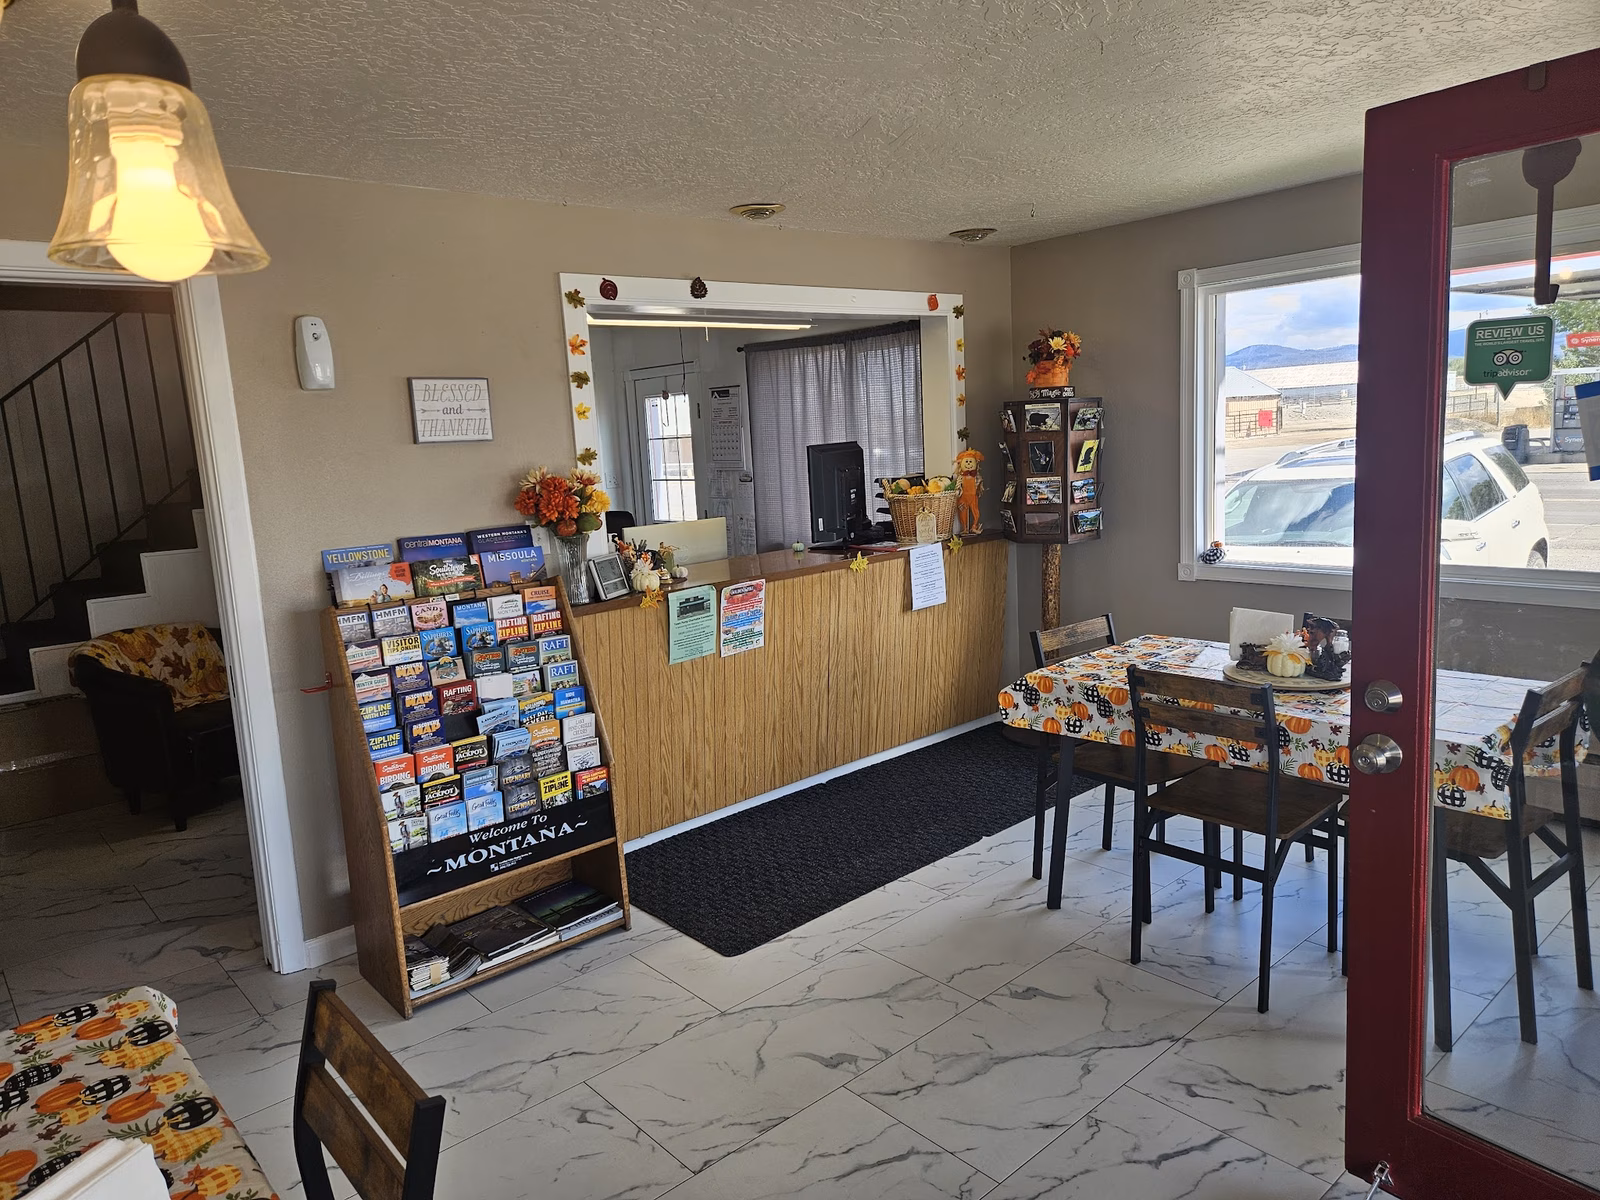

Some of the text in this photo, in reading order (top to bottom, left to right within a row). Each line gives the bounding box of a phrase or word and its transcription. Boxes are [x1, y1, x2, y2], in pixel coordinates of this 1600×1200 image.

[1475, 325, 1544, 340] REVIEW US
[1483, 367, 1530, 379] tripadvisor
[421, 383, 482, 403] BLESSED
[442, 404, 464, 415] and
[420, 417, 489, 438] THANKFUL
[326, 548, 391, 564] YELLOWSTONE
[487, 550, 537, 563] MISSOULA
[414, 605, 444, 617] CANDY
[456, 602, 486, 611] MONTANA
[375, 607, 406, 620] HMFM
[533, 610, 561, 622] RAFTING
[497, 617, 527, 628] RAFTING
[534, 620, 562, 631] ZIPLINE
[498, 625, 528, 637] ZIPLINE
[386, 636, 420, 649] VISITOR
[387, 643, 420, 654] TIPS ONLINE
[542, 639, 568, 651] RAFT
[395, 665, 424, 678] MAP
[551, 664, 576, 677] RAFT
[356, 680, 373, 688] WINTER
[443, 685, 472, 698] RAFTING
[405, 694, 434, 708] MAP
[359, 702, 392, 715] ZIPLINE
[363, 709, 390, 720] WITH US!
[412, 723, 441, 737] MAP
[369, 732, 401, 746] ZIPLINE
[371, 739, 399, 751] WITH US!
[455, 748, 485, 762] JACKPOT
[420, 761, 450, 776] BIRDING
[380, 771, 411, 785] BIRDING
[502, 772, 532, 785] LEGENDARY
[543, 781, 569, 795] ZIPLINE
[424, 788, 454, 802] JACKPOT
[508, 799, 537, 813] LEGENDARY
[469, 814, 548, 844] Welcome To
